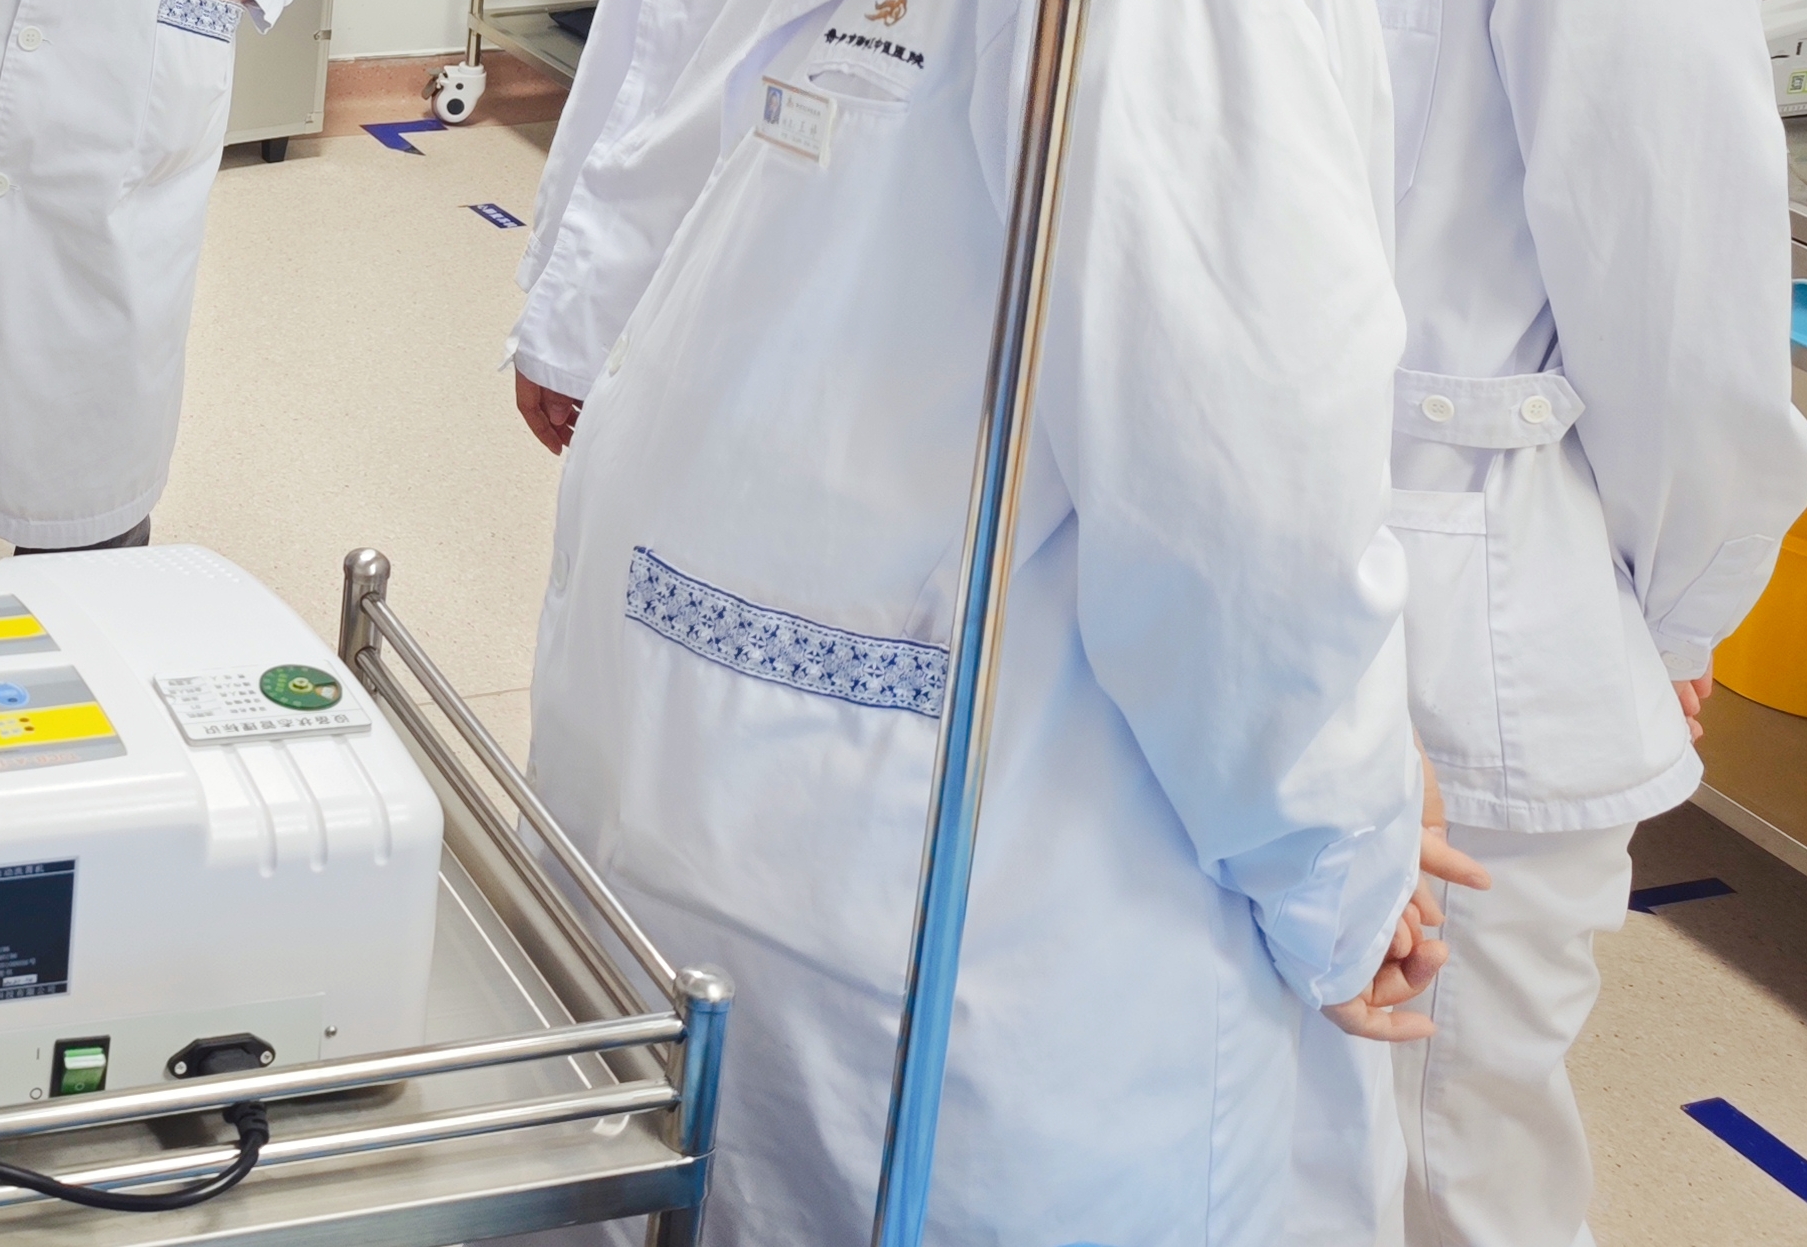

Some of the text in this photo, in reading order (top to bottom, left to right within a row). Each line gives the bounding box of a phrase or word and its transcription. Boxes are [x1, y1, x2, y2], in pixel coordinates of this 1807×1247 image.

[202, 714, 350, 735] 设备状态管理标识
